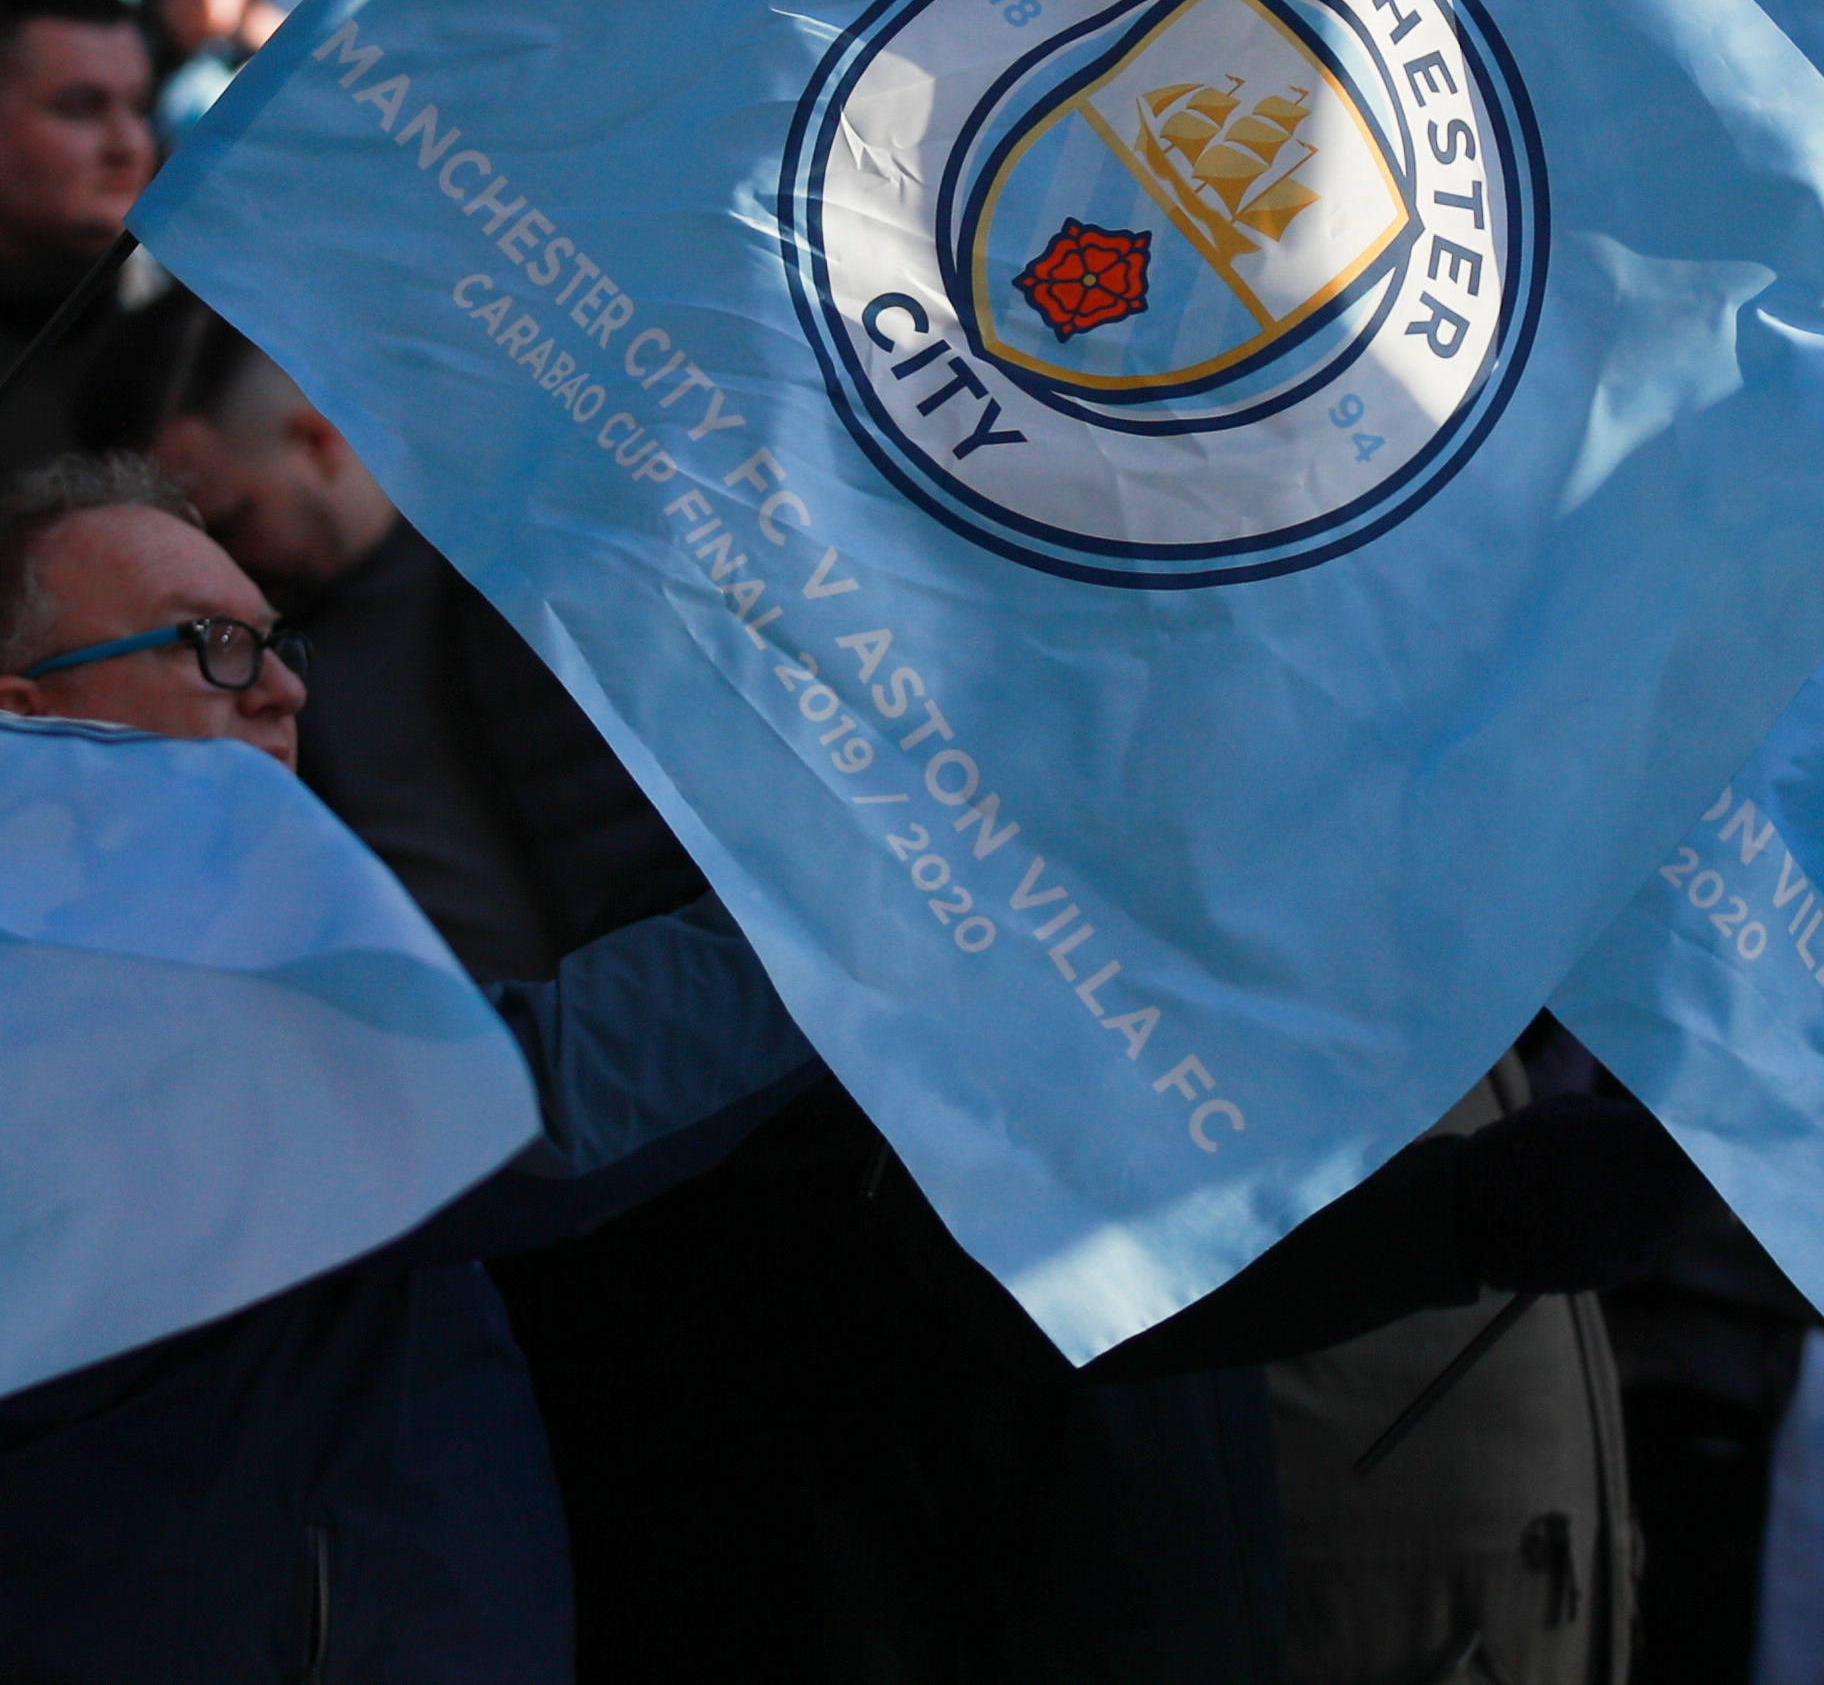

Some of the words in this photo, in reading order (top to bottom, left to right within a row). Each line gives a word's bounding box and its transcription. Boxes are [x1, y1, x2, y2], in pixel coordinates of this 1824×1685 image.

[860, 291, 1027, 463] CITY
[1326, 392, 1386, 466] 94
[312, 20, 635, 349] MANCHESTER
[624, 327, 746, 442] CITY
[723, 446, 811, 546] FC
[802, 546, 860, 600] V
[835, 626, 1020, 861] ASTON
[1008, 855, 1162, 1061] VILLA
[1152, 1052, 1246, 1154] FC
[452, 272, 607, 423] CARABAO
[596, 411, 677, 485] CUP
[663, 488, 784, 651] FINAL
[773, 652, 874, 775] 2019
[886, 821, 997, 954] 2020
[1658, 845, 1768, 961] 2020
